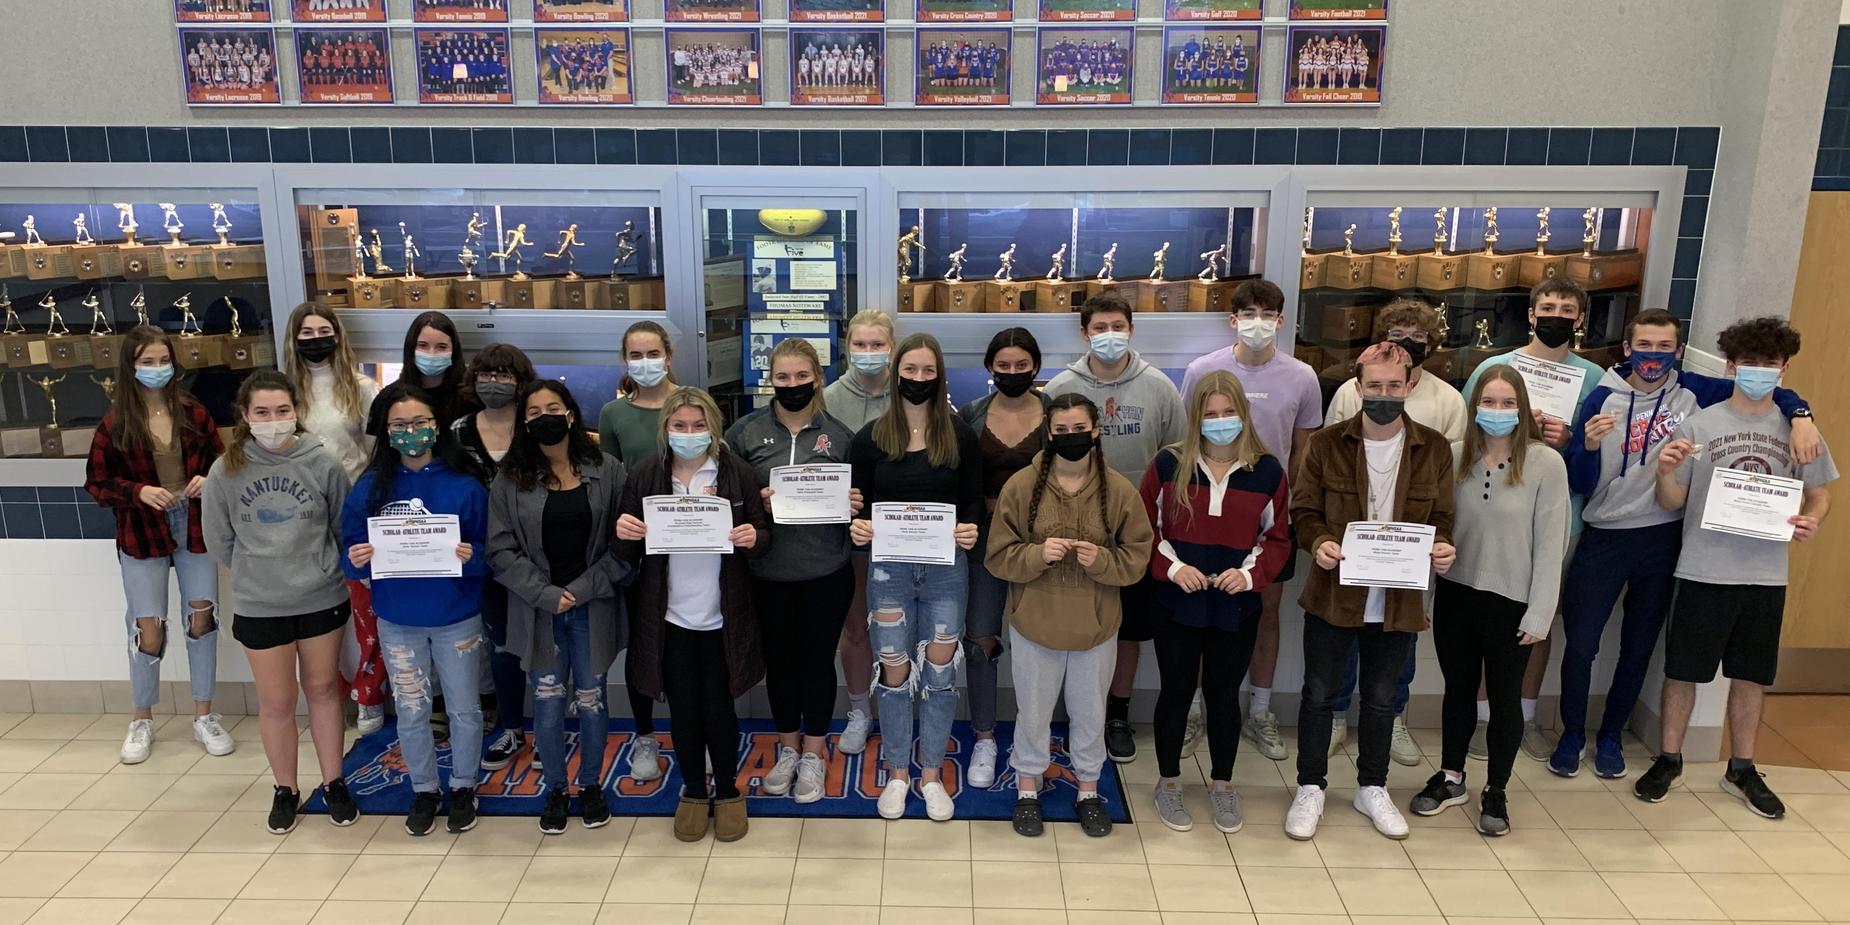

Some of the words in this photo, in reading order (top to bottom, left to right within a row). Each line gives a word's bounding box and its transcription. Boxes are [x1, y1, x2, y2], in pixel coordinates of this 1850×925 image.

[684, 12, 702, 20] Varsity
[703, 12, 728, 20] Wrestling
[807, 12, 825, 20] Varsity
[933, 12, 949, 20] Varsity
[965, 12, 983, 20] Country
[1060, 11, 1079, 19] Varsity
[1191, 10, 1210, 18] Varsity
[1057, 94, 1075, 102] Varsity
[754, 355, 768, 367] 20
[1549, 373, 1558, 381] TEAM
[1708, 437, 1723, 452] 2021
[1724, 434, 1737, 444] New
[1738, 432, 1751, 441] York
[1752, 432, 1767, 443] State
[1711, 449, 1726, 463] Cross
[1728, 444, 1751, 455] Country
[240, 476, 313, 507] NANTUCKET
[1762, 487, 1773, 495] TEAM
